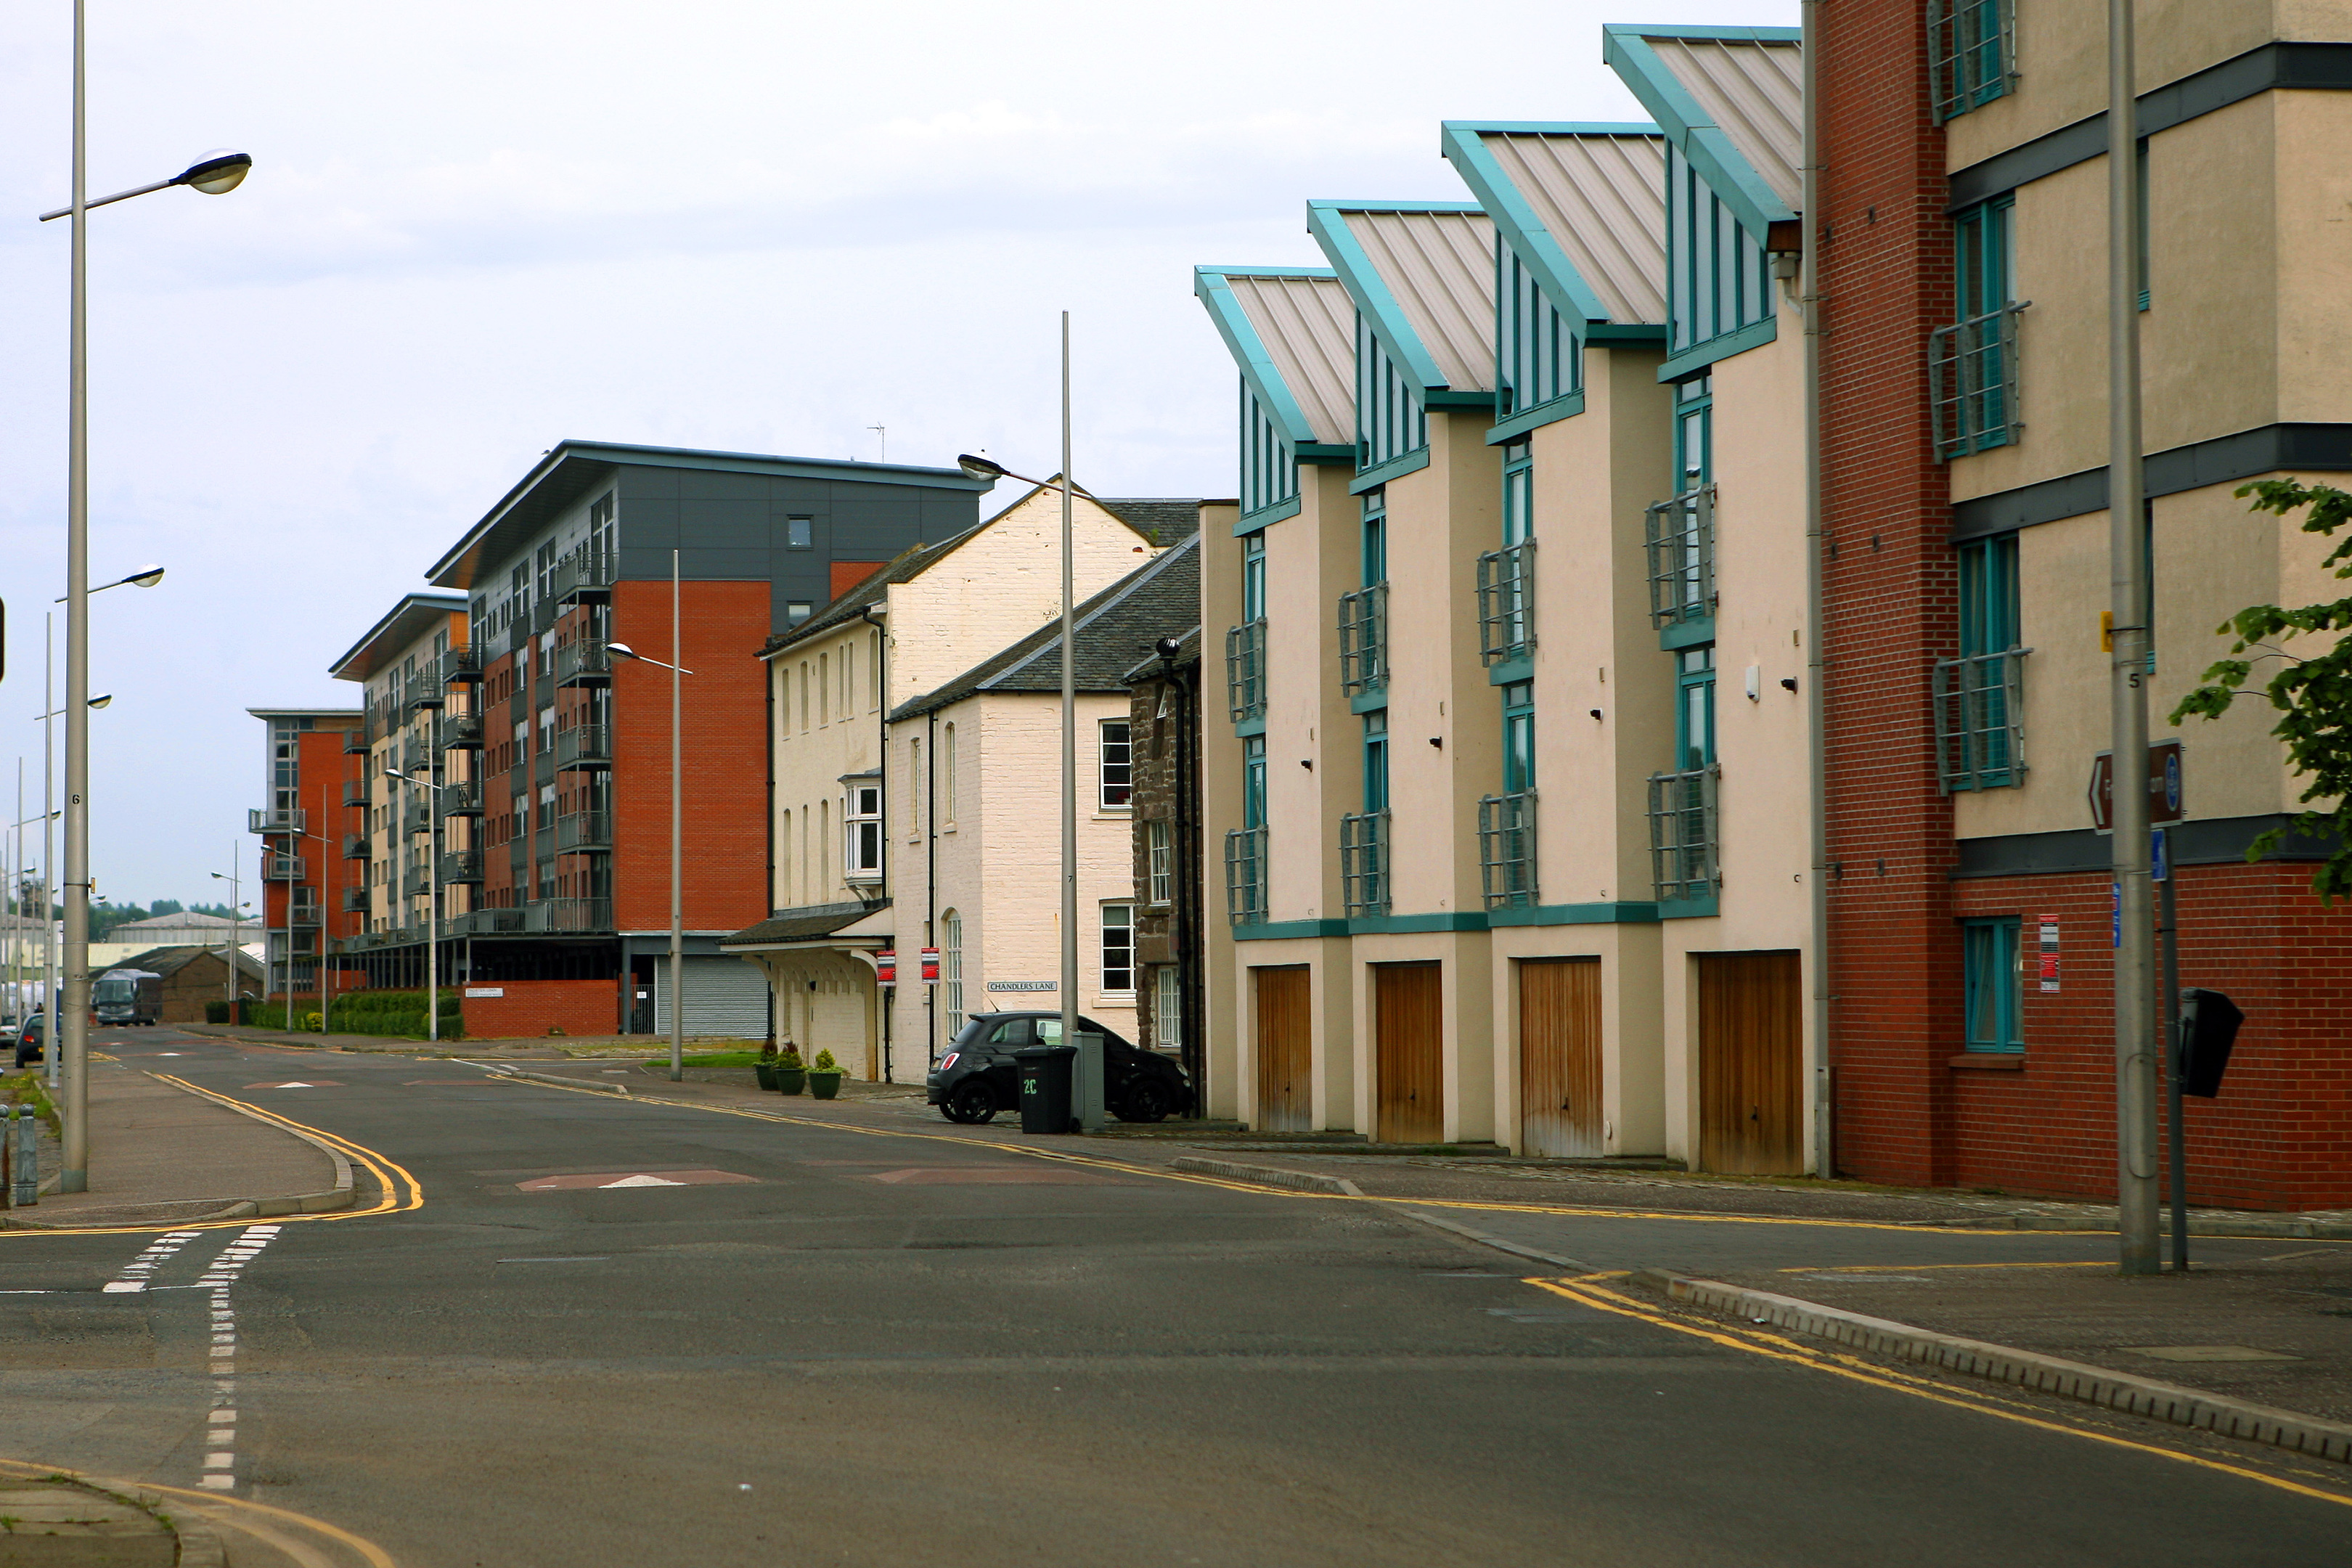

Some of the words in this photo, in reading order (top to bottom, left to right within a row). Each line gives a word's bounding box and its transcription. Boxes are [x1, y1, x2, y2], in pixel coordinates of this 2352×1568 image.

[2128, 673, 2140, 689] 5
[72, 794, 80, 804] 6
[1024, 1079, 1037, 1095] 2C
